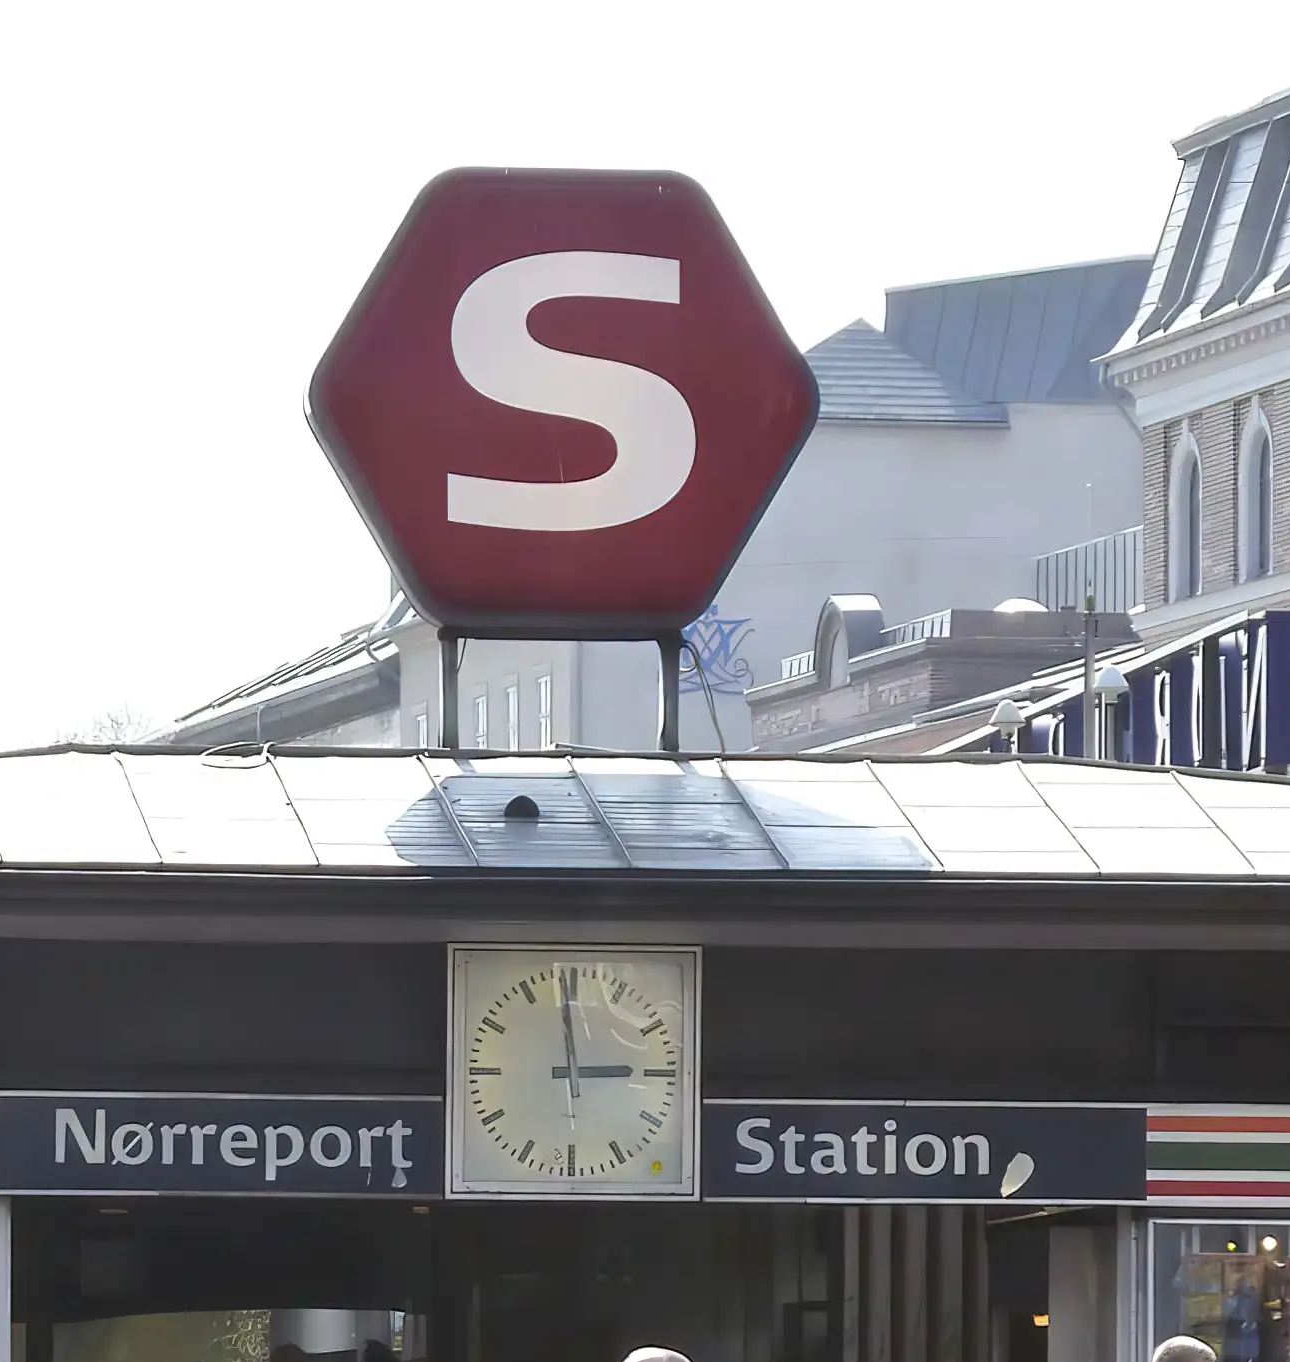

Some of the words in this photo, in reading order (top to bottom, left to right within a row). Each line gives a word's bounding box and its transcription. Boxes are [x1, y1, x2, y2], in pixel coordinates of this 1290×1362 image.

[447, 250, 697, 532] S
[55, 1108, 413, 1181] Nørreport
[735, 1117, 991, 1176] Station
